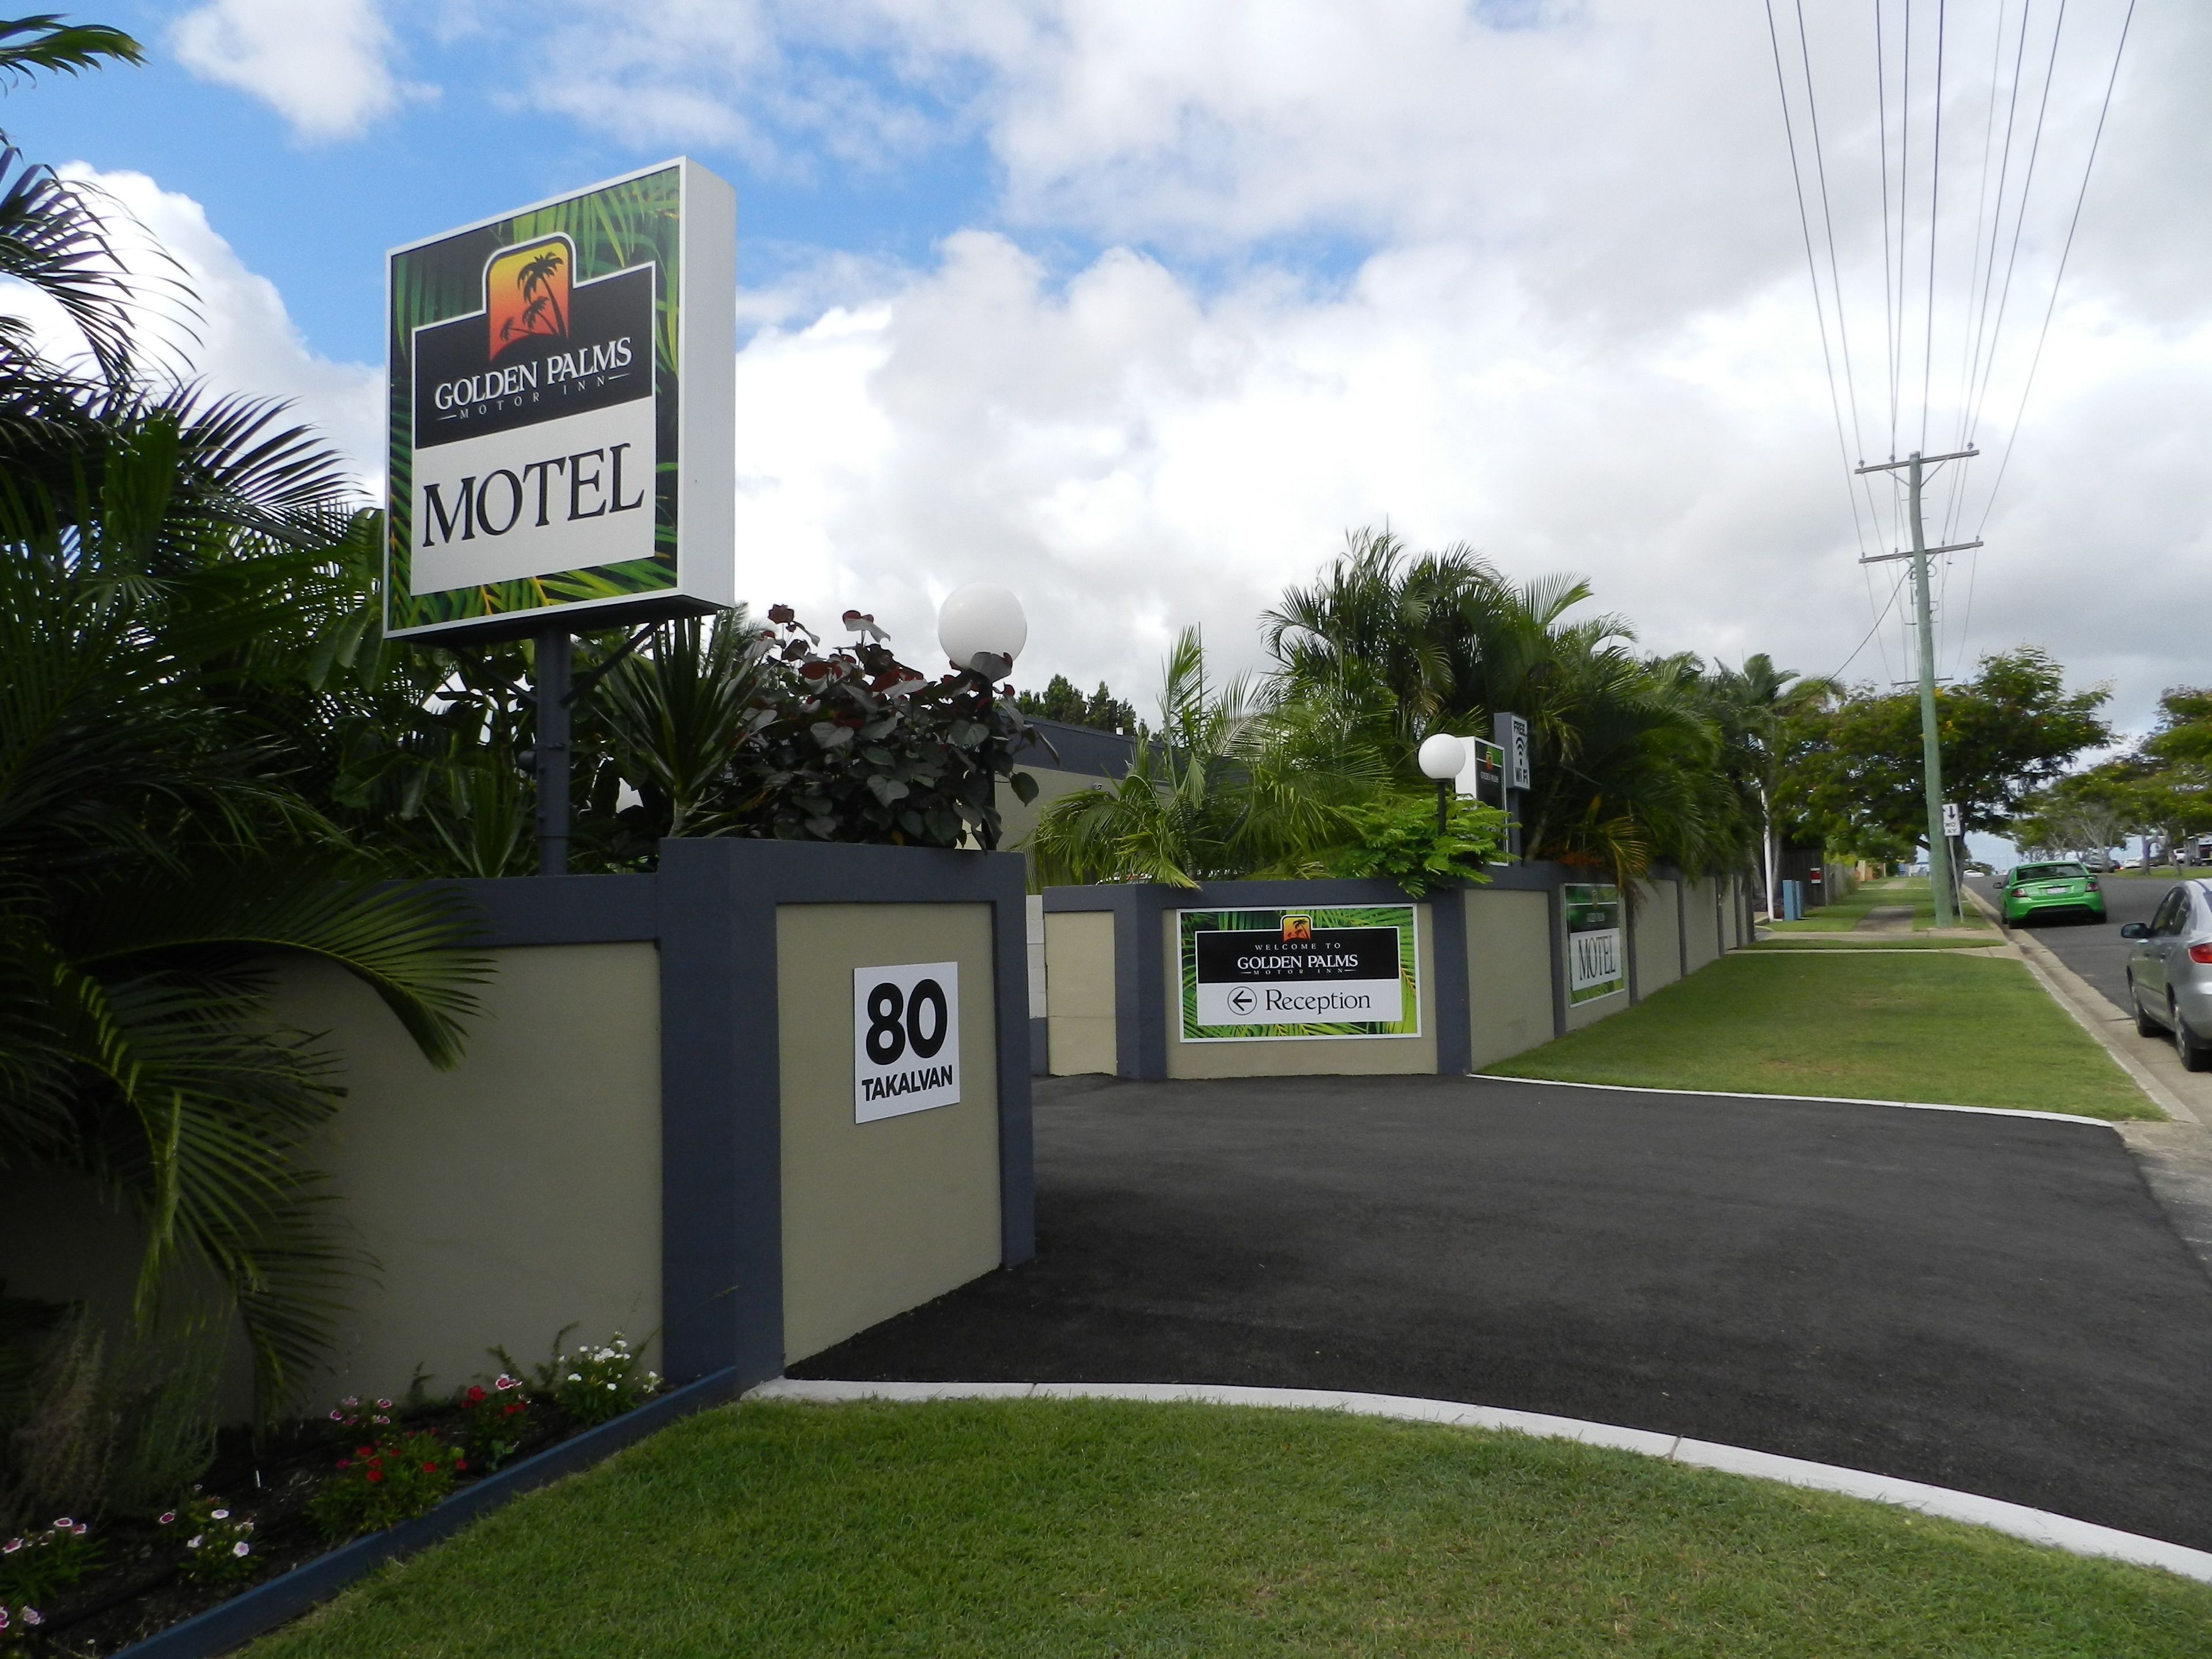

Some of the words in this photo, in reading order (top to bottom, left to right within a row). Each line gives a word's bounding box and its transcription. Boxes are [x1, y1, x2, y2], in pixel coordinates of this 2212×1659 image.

[435, 361, 537, 410] GOLDEN
[547, 336, 632, 385] PALMS
[460, 392, 540, 419] MOTOR
[563, 376, 605, 395] INN
[422, 443, 645, 547] MOTEL
[1237, 956, 1302, 969] GOLDEN
[1308, 954, 1358, 968] PALMS
[1578, 935, 1616, 980] MOTEL
[866, 979, 948, 1065] 80
[1265, 989, 1371, 1015] Reception
[862, 1065, 953, 1101] TAKALVAN
